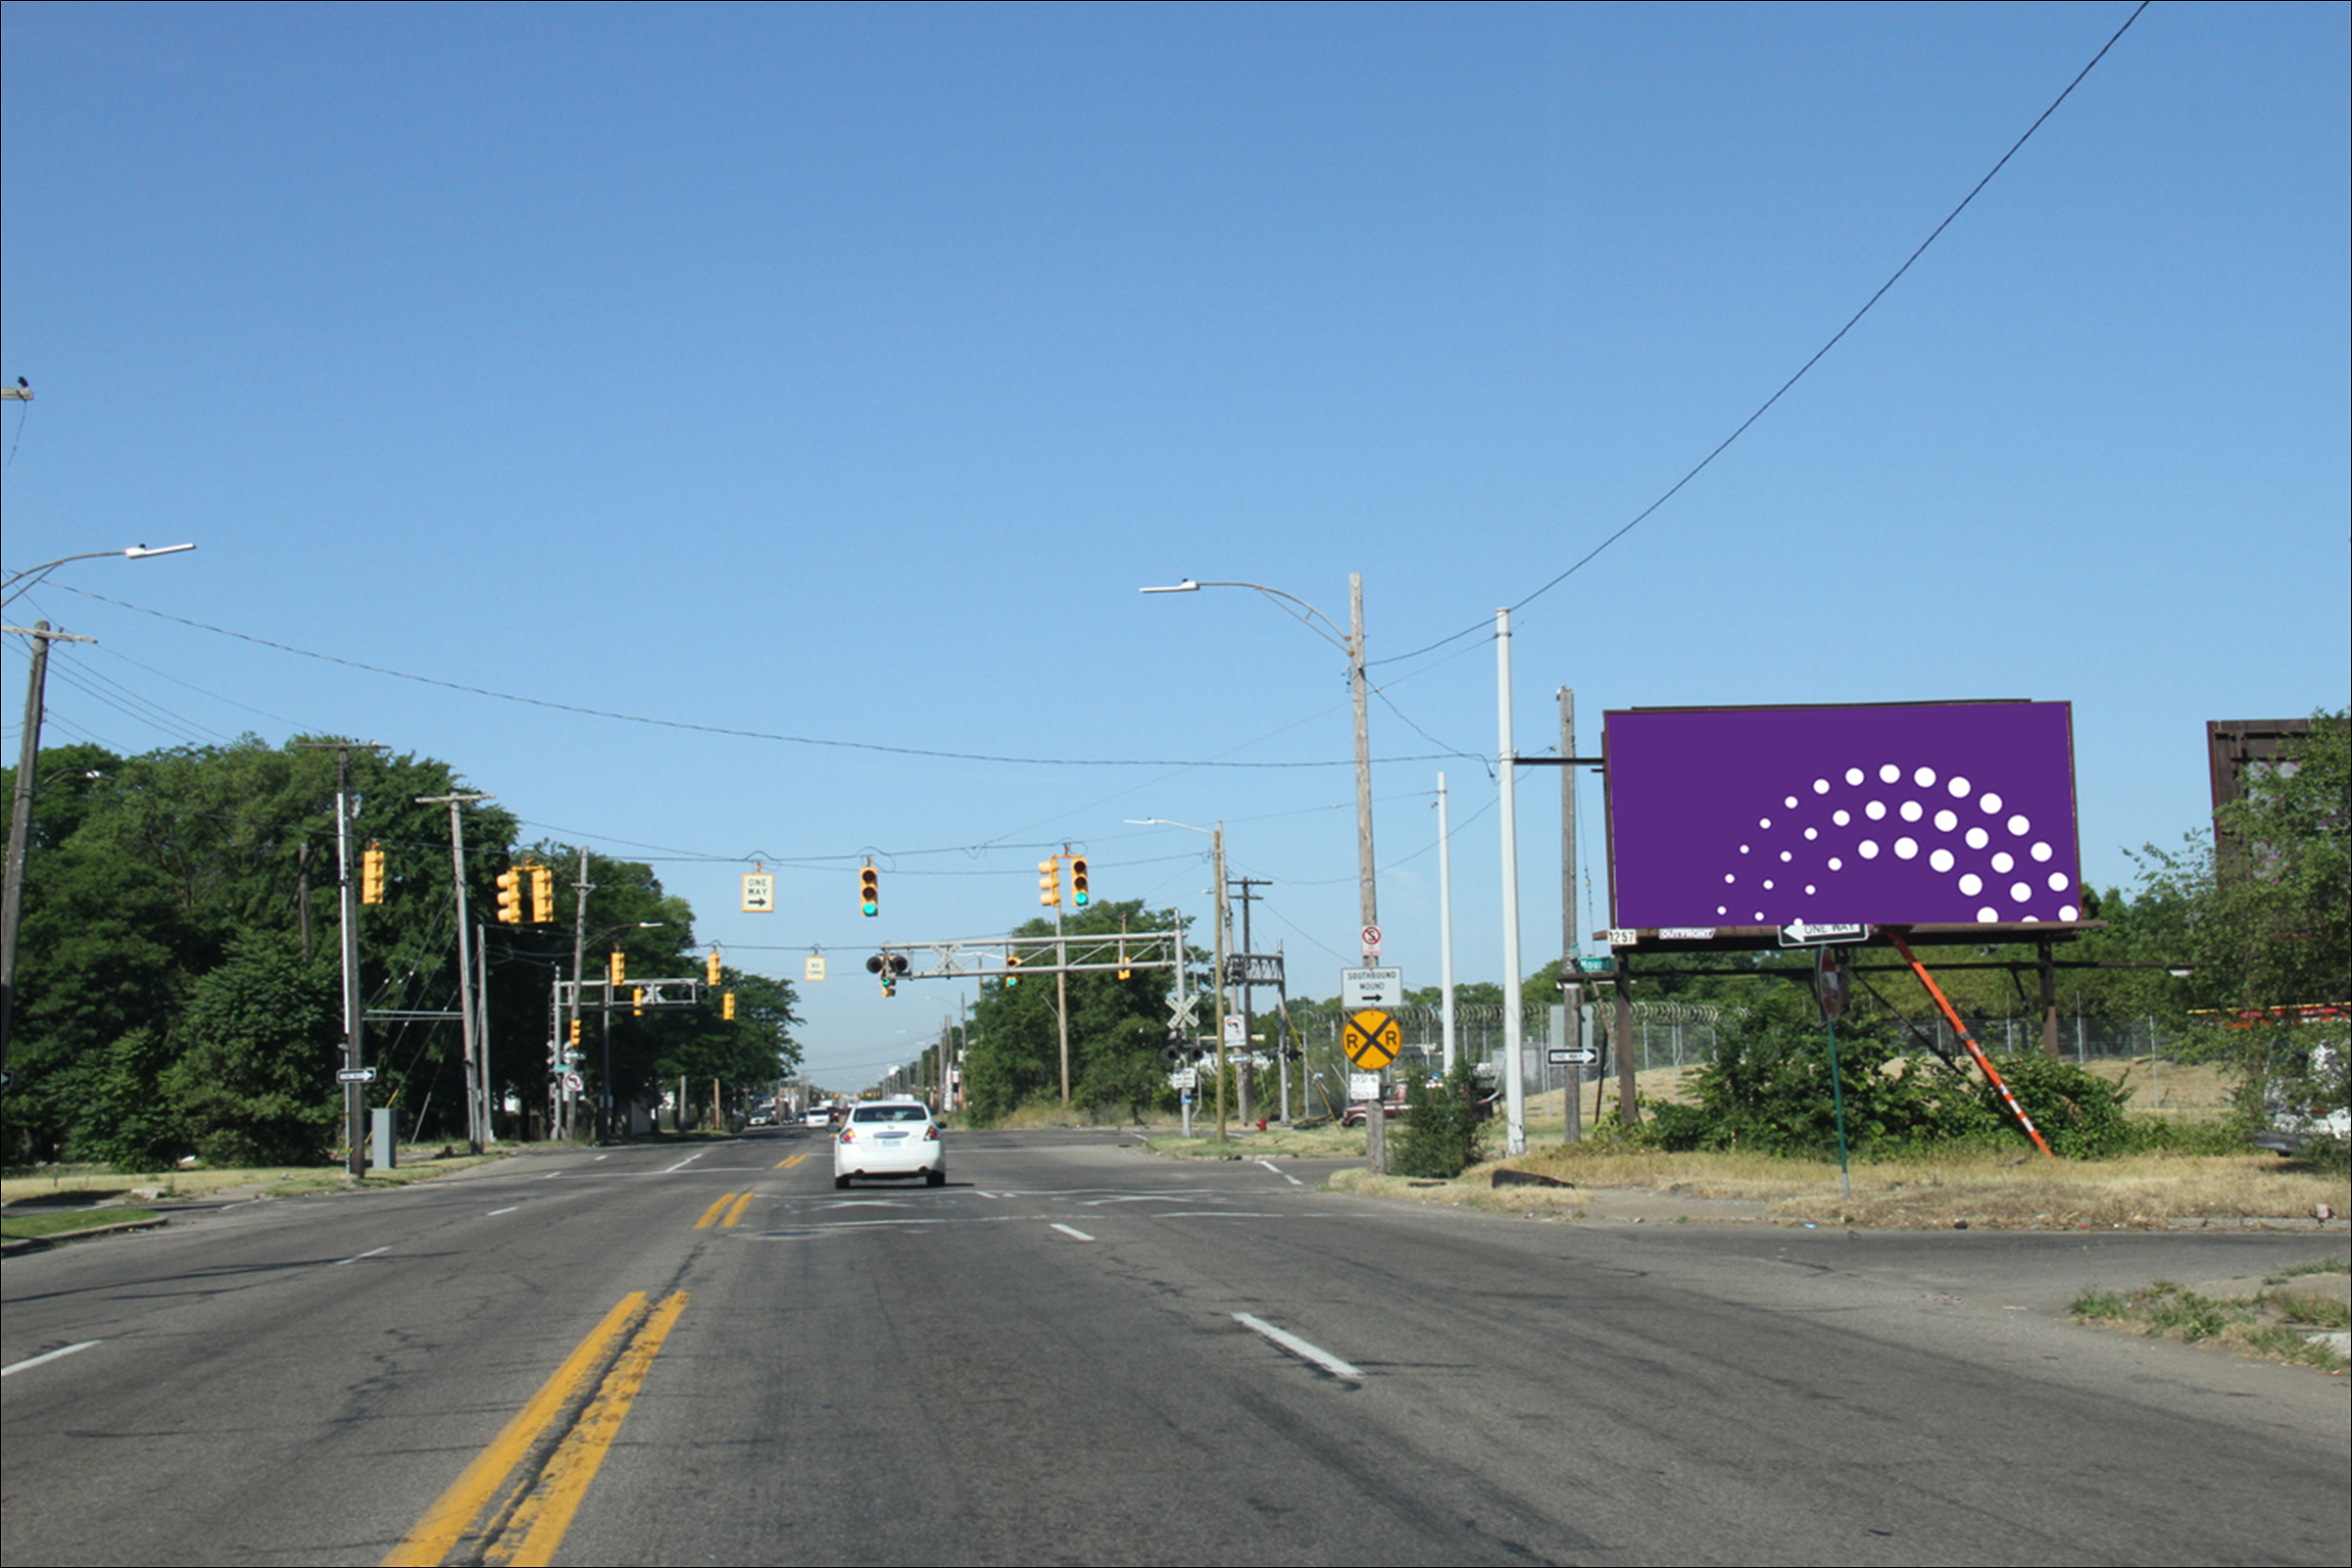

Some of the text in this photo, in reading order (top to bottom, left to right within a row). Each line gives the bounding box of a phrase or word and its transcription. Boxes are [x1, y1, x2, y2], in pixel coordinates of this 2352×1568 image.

[748, 878, 767, 887] ONE
[1660, 928, 1713, 938] OUTFRONT
[1804, 924, 1828, 935] ONE
[1608, 930, 1635, 943] 1257
[1348, 971, 1397, 981] SOUTHBOUND
[1359, 982, 1385, 991] MOUND
[1346, 1031, 1397, 1049] R R
